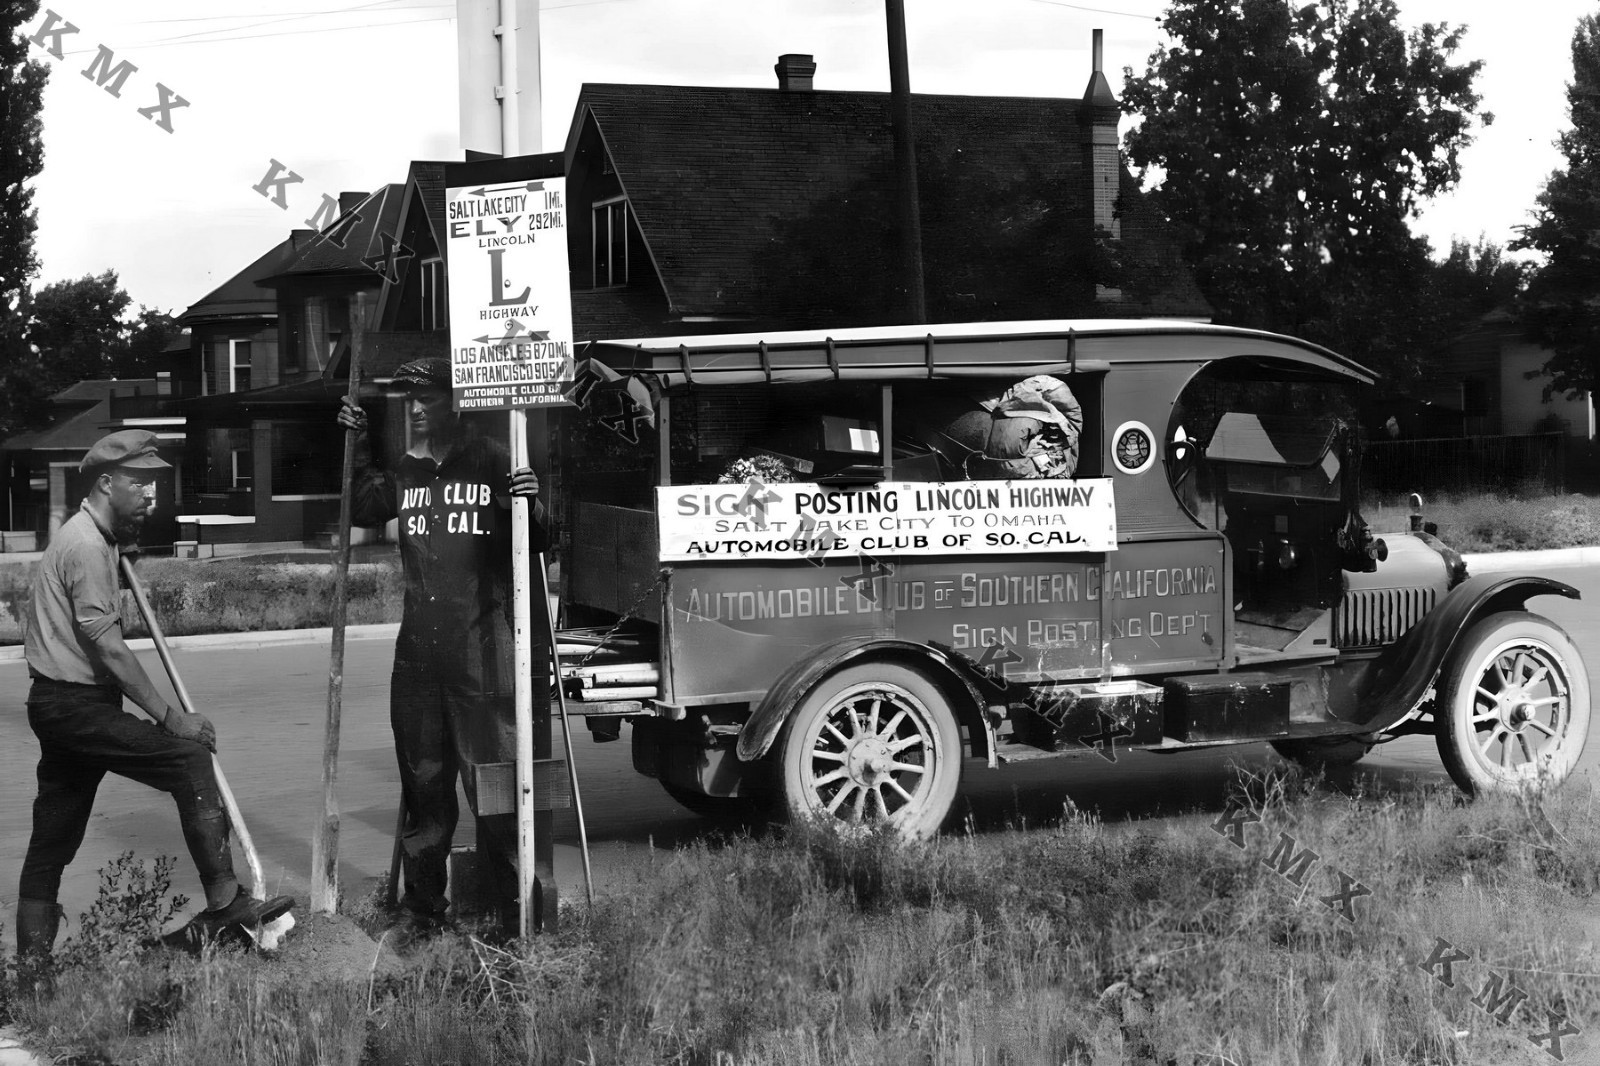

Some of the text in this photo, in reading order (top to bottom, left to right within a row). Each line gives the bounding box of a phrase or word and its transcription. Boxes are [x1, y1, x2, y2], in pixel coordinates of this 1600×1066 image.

[449, 200, 475, 220] SALT
[477, 197, 503, 217] LAKE
[504, 194, 527, 214] CITY
[450, 215, 522, 239] ELY
[478, 233, 536, 248] LINCOLN
[487, 248, 532, 307] L
[479, 305, 539, 320] HIGHWAY
[454, 346, 476, 365] LOS
[479, 342, 532, 364] ANGELES
[455, 366, 474, 384] SAN
[475, 363, 533, 384] FRANCISCO
[401, 482, 492, 510] AUTO CLUB
[795, 490, 898, 515] POSTING
[916, 487, 1000, 512] LINCOLN
[1010, 486, 1095, 508] HIGHWAY
[407, 511, 491, 536] SO. CAL.
[714, 512, 1067, 533] SALT LAKE CITY TO OMAHA
[686, 530, 1087, 554] AUTOMOBILE CLUB OF SO. CAL.
[686, 588, 849, 623] AUTOMOBILE
[935, 588, 954, 601] OF
[960, 572, 1079, 608] SOUTHERN
[1086, 566, 1217, 602] CALIFORNIA
[952, 611, 1212, 650] SIGN POSTING DEP'T
